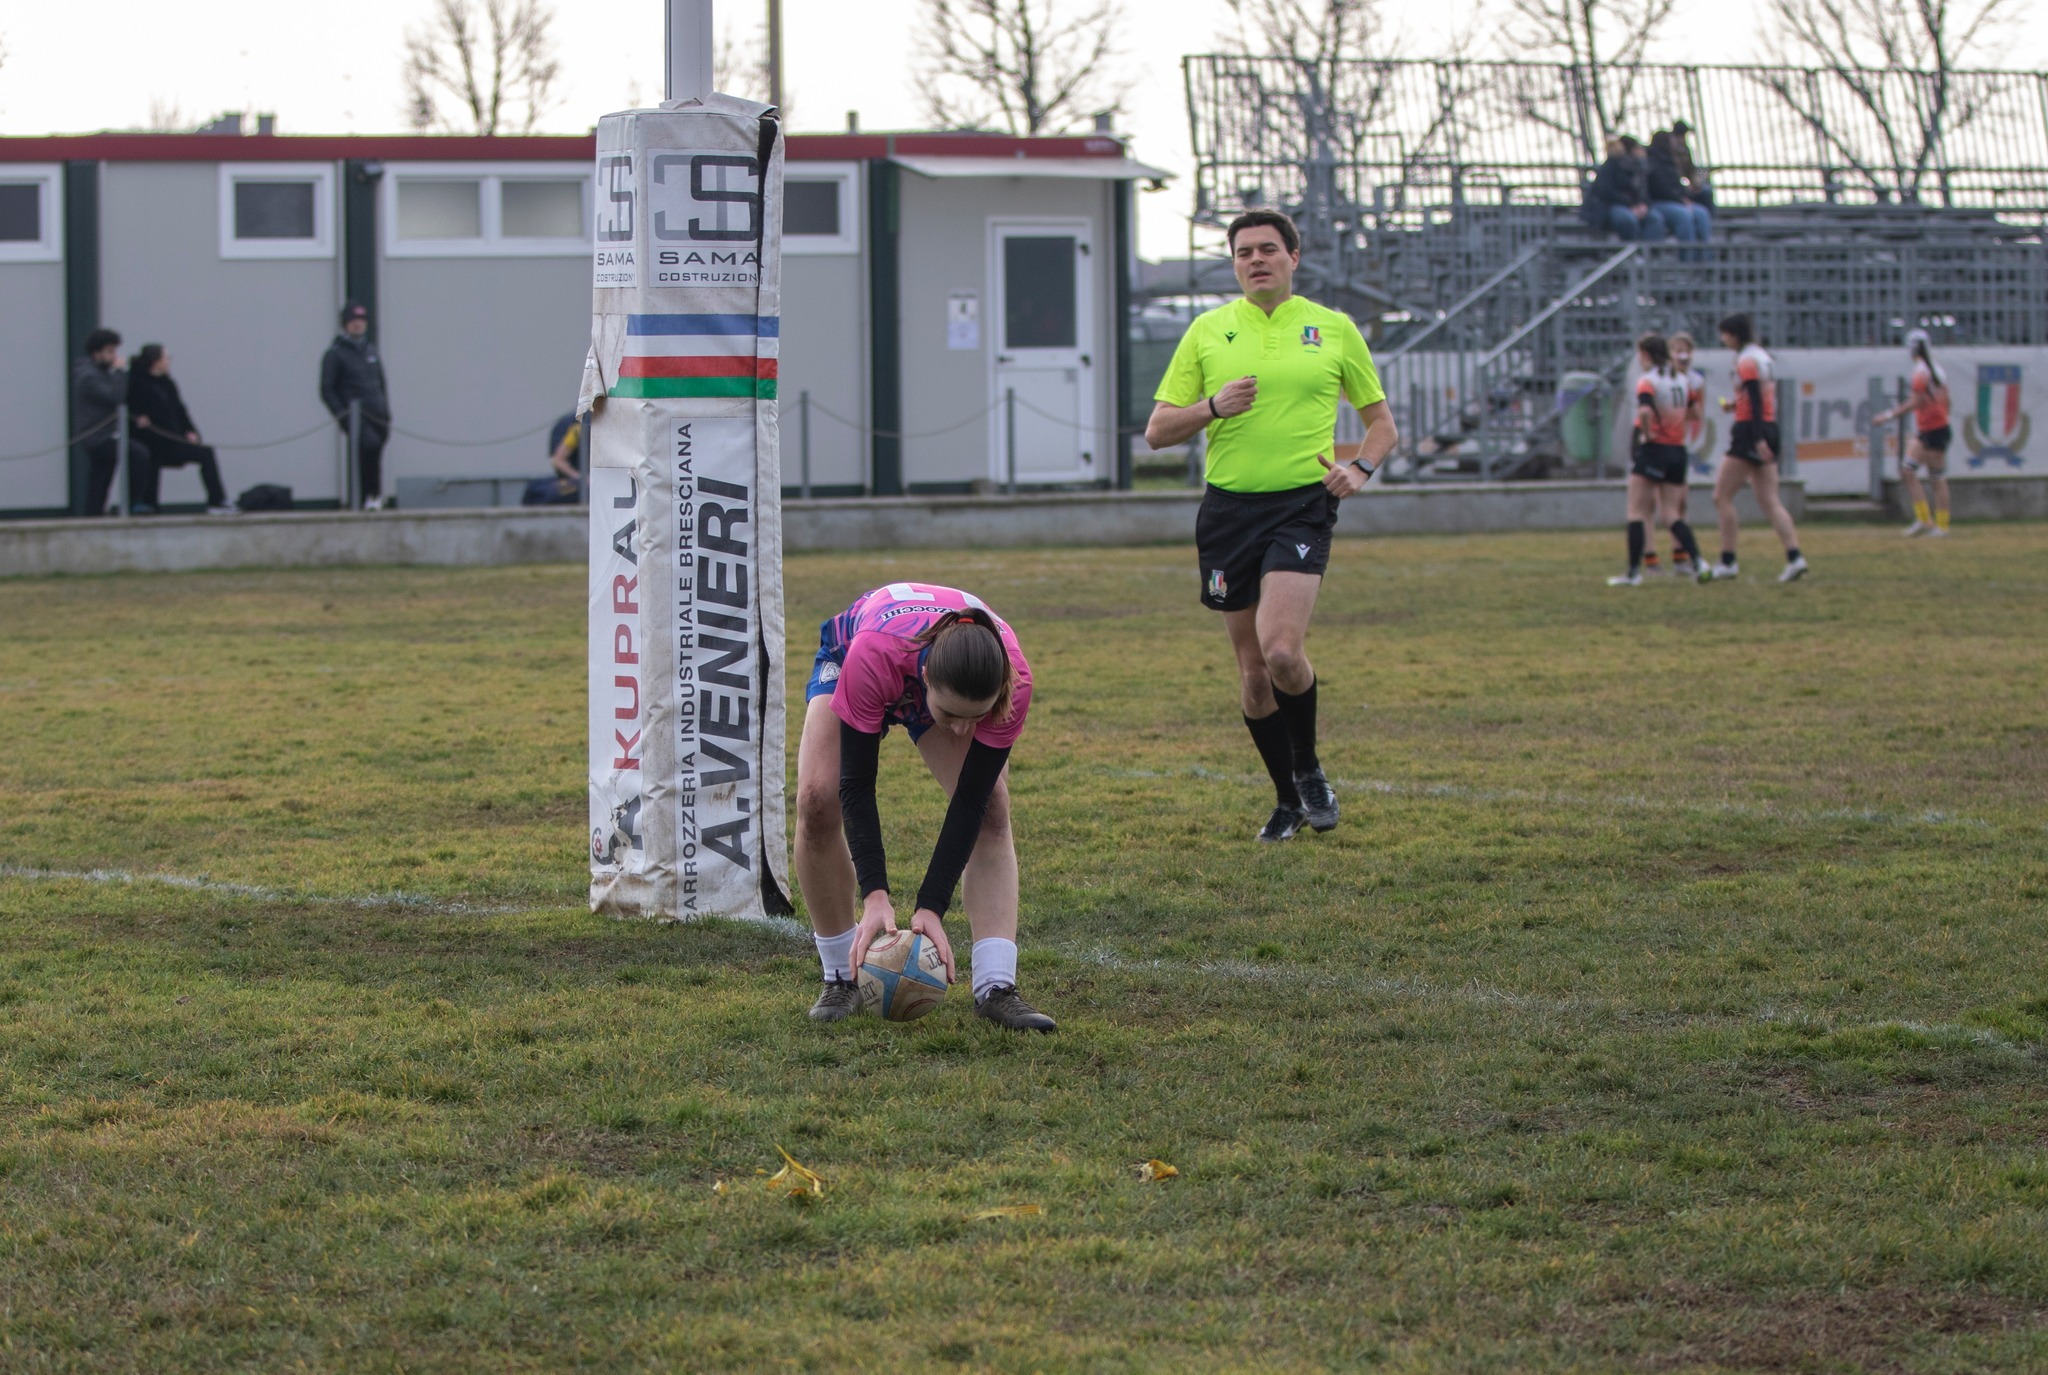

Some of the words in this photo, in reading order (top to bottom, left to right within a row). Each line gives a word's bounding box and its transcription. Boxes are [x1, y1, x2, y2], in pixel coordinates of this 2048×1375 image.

[597, 252, 635, 266] SAMA
[659, 252, 764, 268] SAMA
[678, 423, 693, 567] BRESCIANA
[612, 476, 641, 770] KUPRAL
[679, 577, 695, 742] INDUSTRIALE
